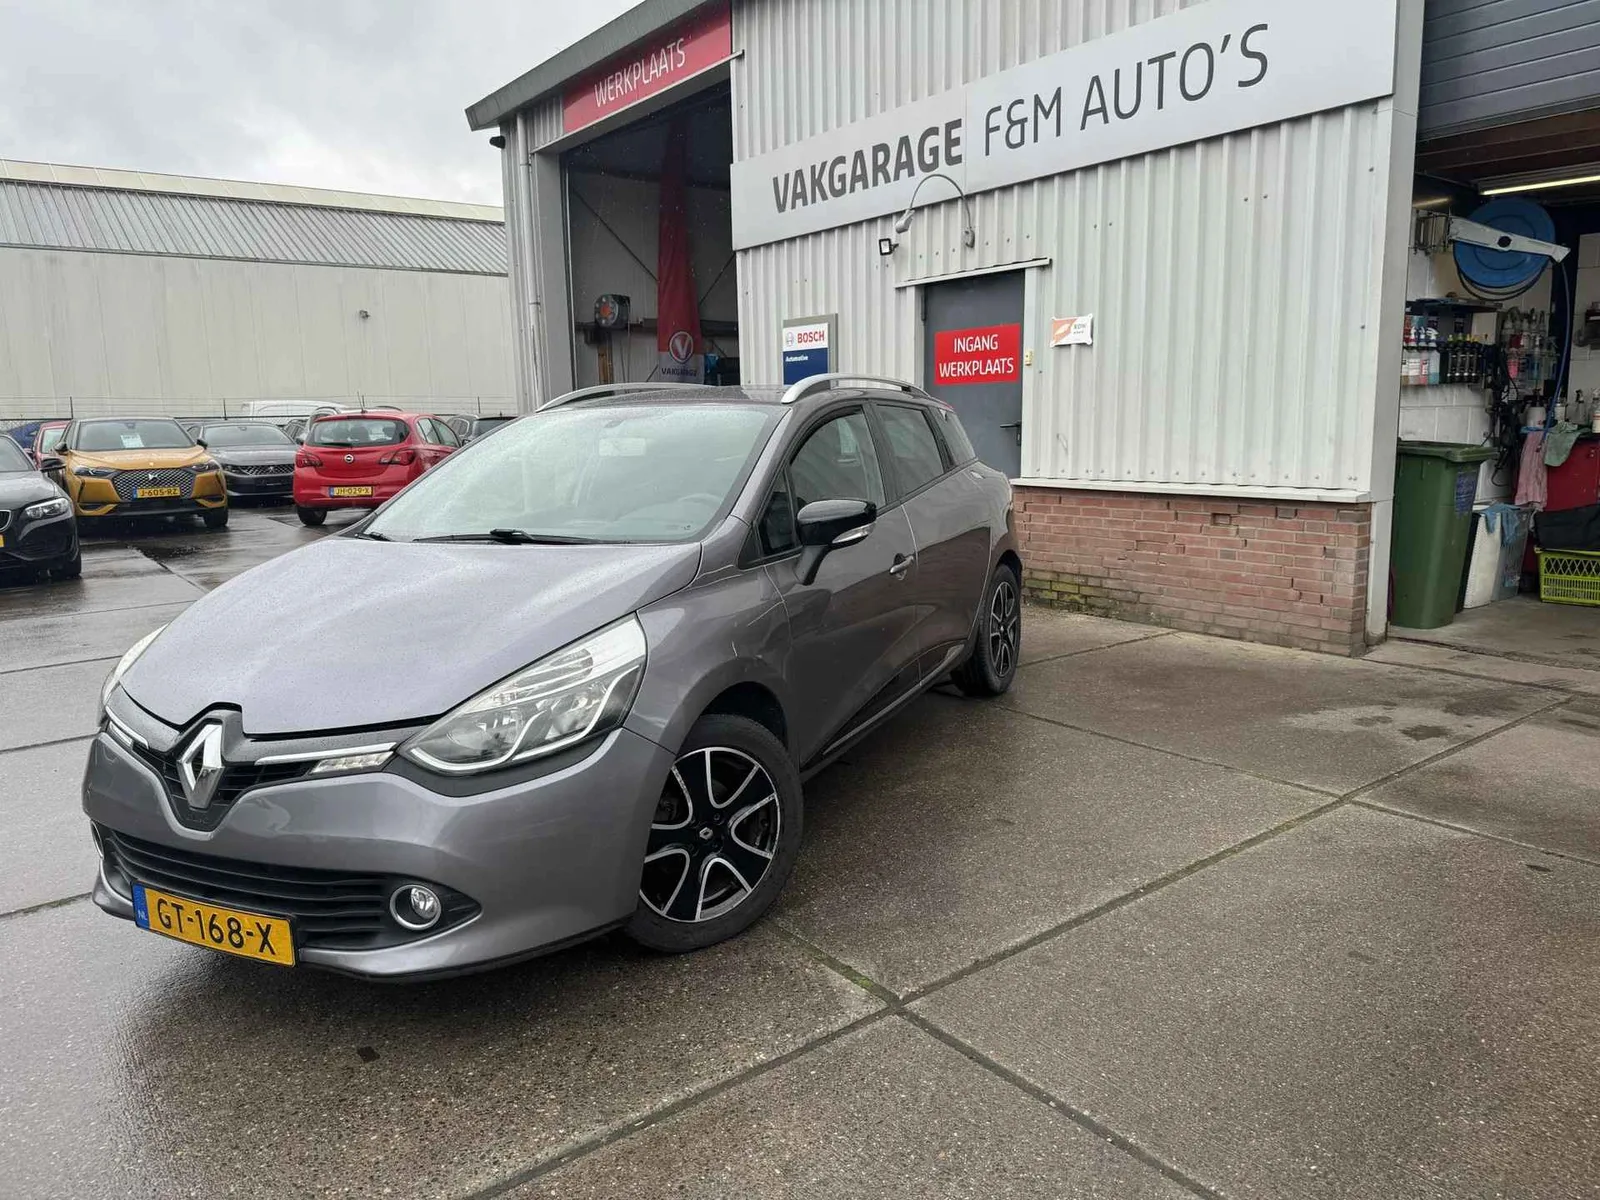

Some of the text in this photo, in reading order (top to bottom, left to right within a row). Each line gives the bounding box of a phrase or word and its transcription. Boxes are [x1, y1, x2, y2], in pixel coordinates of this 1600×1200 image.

[594, 38, 686, 107] WERKPLAATS
[773, 23, 1268, 214] VAKGARAGE F&M AUTO'S
[797, 330, 825, 344] BOSCH
[954, 333, 999, 353] INGANG
[939, 357, 1014, 378] WERKPLAATS
[335, 487, 370, 496] JH-029-X
[157, 898, 276, 956] GT-168-X
